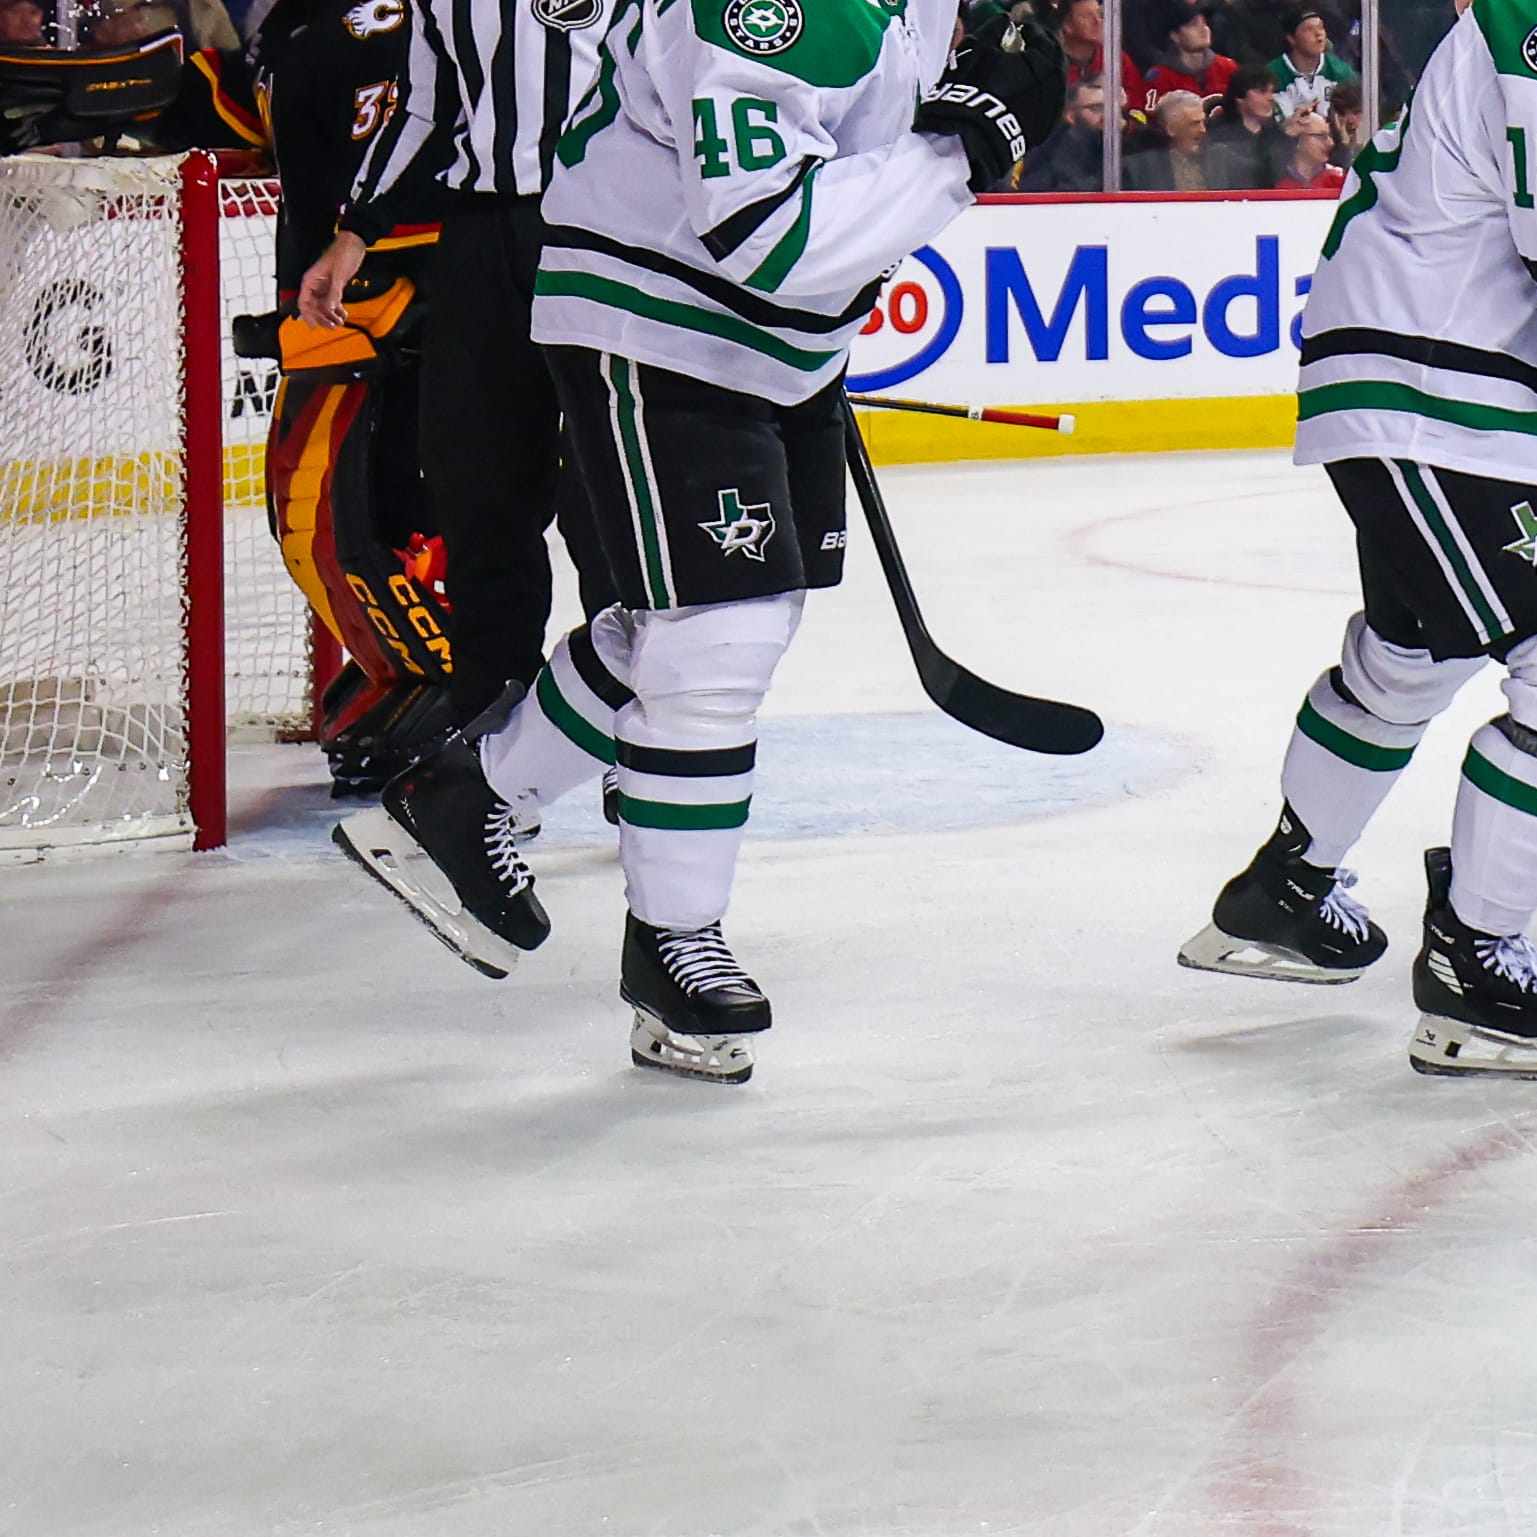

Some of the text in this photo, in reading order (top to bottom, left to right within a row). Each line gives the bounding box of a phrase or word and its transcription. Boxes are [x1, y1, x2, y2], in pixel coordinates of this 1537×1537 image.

[729, 16, 785, 52] STARS
[692, 97, 787, 179] 46
[346, 573, 425, 676] CCM
[388, 573, 454, 674] CCM
[1285, 878, 1316, 902] TRUE
[1430, 923, 1456, 945] TRUE
